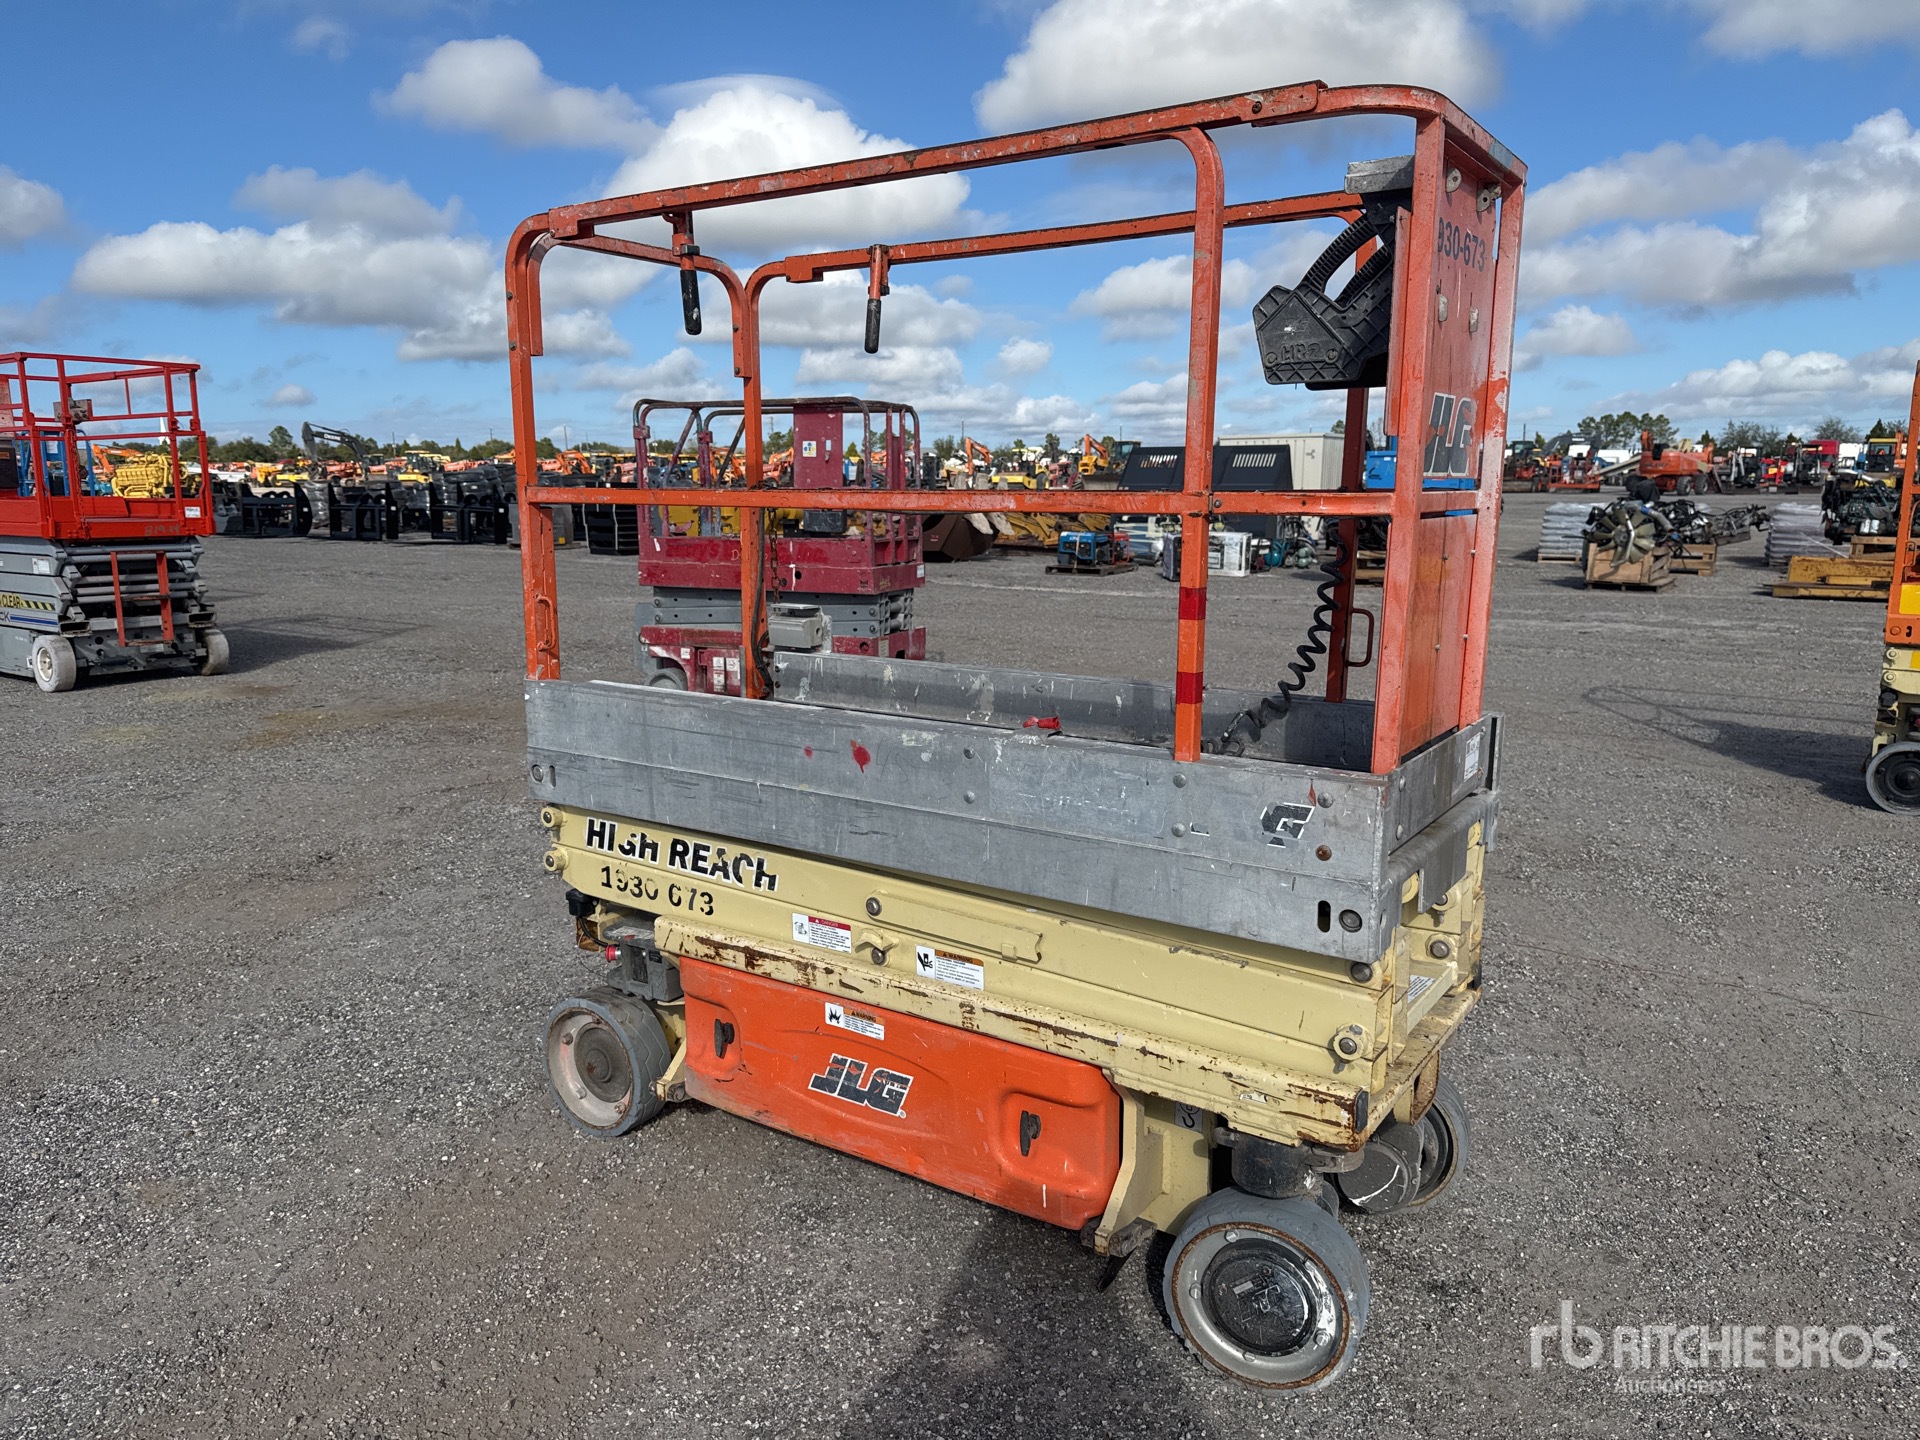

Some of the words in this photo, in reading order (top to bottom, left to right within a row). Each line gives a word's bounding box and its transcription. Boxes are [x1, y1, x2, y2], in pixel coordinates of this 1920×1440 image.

[586, 817, 660, 864] HIGH
[667, 837, 780, 893] REACH
[808, 1052, 914, 1117] JLG
